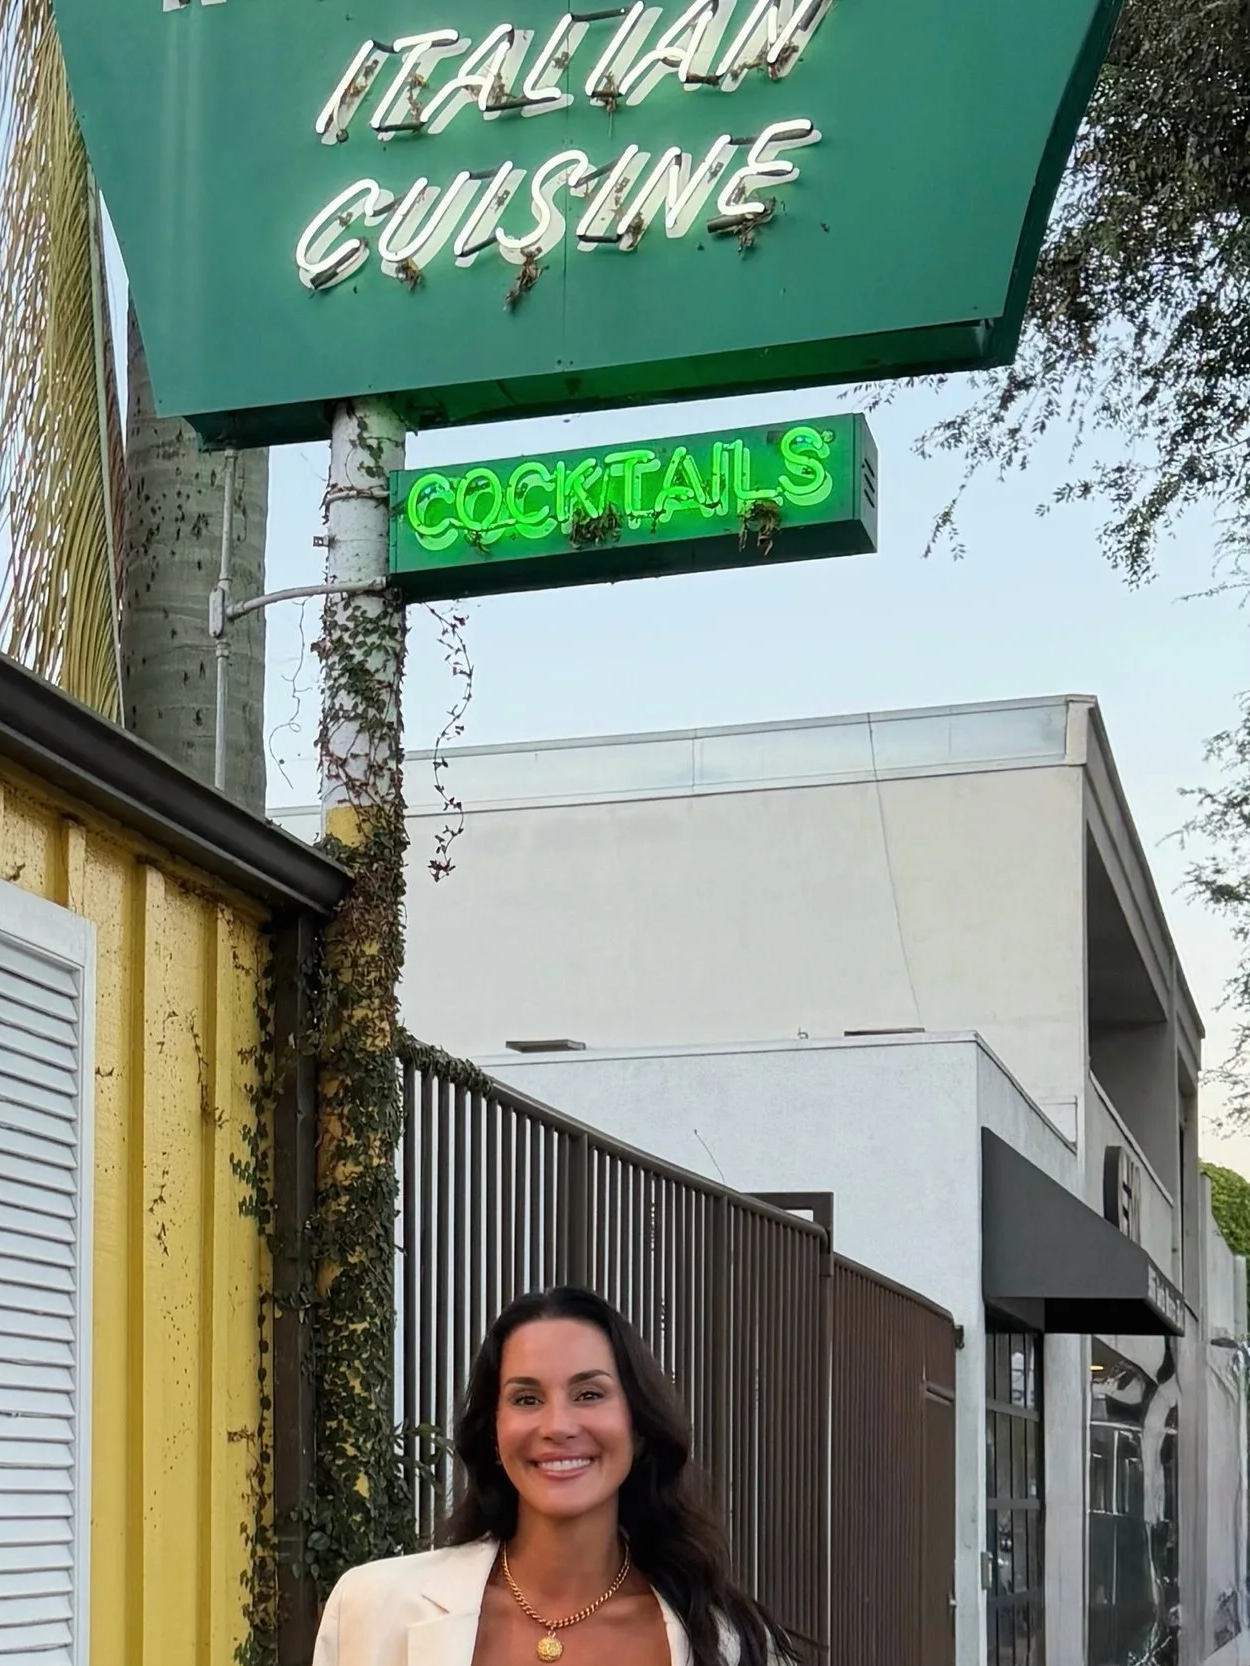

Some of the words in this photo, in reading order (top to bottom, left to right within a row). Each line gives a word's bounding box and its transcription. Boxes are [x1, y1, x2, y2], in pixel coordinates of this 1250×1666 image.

[315, 0, 830, 144] ITALIAN
[296, 119, 822, 288] CUISINE
[408, 427, 833, 551] COCKTAILS
